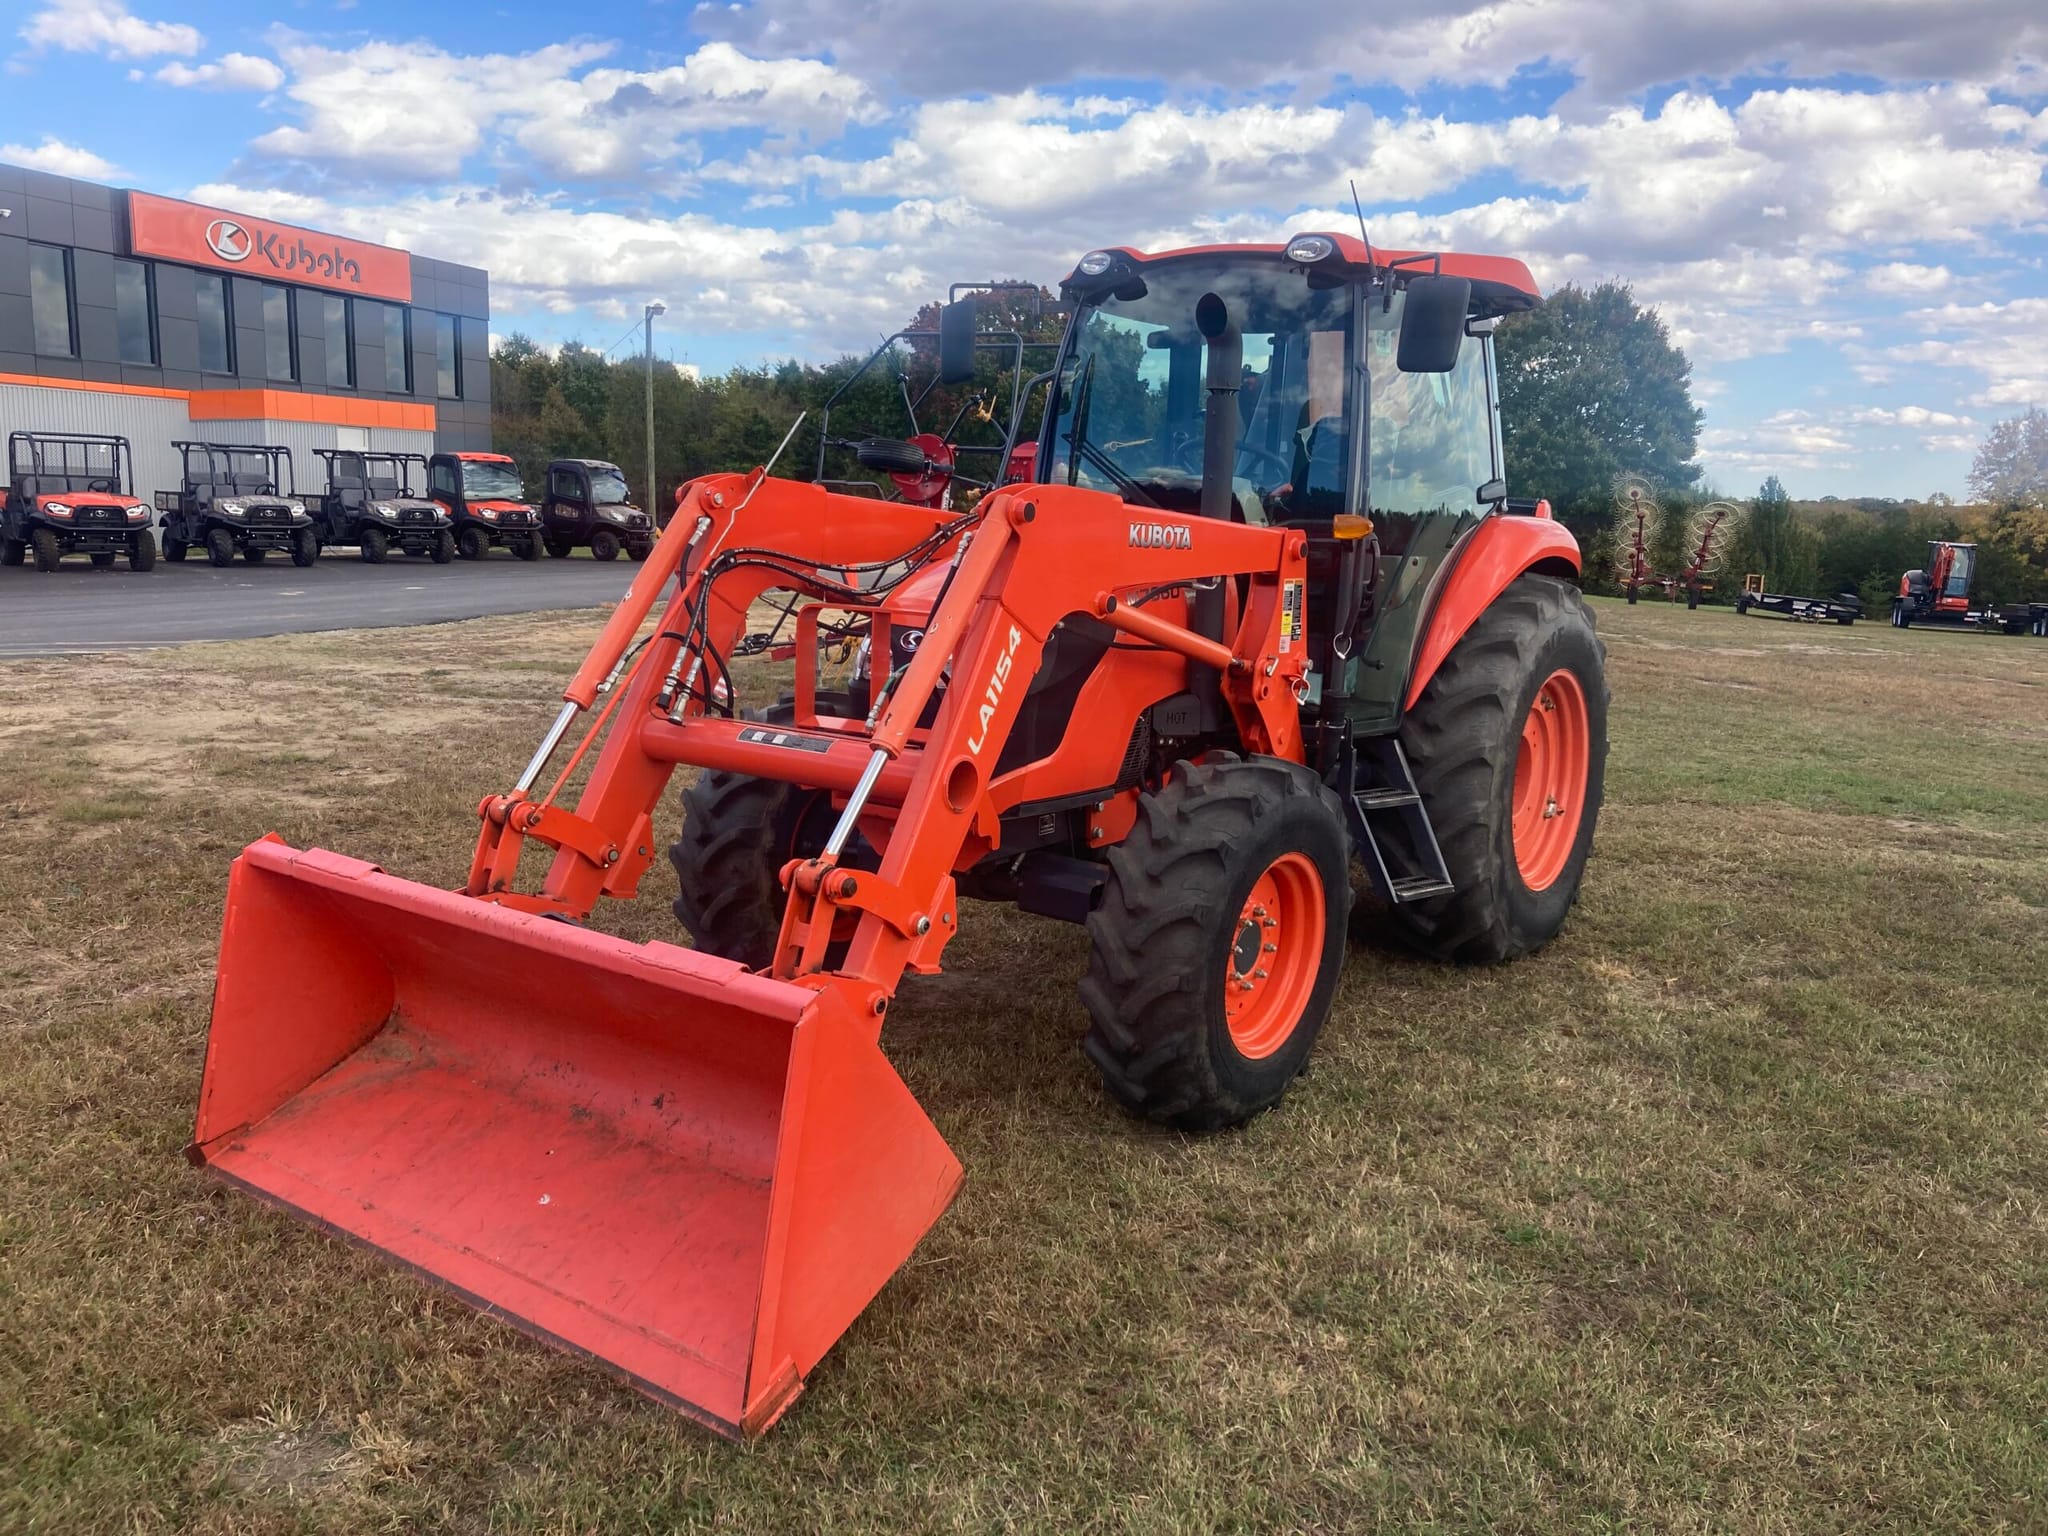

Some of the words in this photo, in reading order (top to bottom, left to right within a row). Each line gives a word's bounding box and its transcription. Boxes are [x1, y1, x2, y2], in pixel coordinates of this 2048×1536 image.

[255, 230, 361, 283] Kubota
[1128, 523, 1192, 550] KUBOTA
[967, 624, 1022, 756] LA1154
[1166, 711, 1188, 725] HOT
